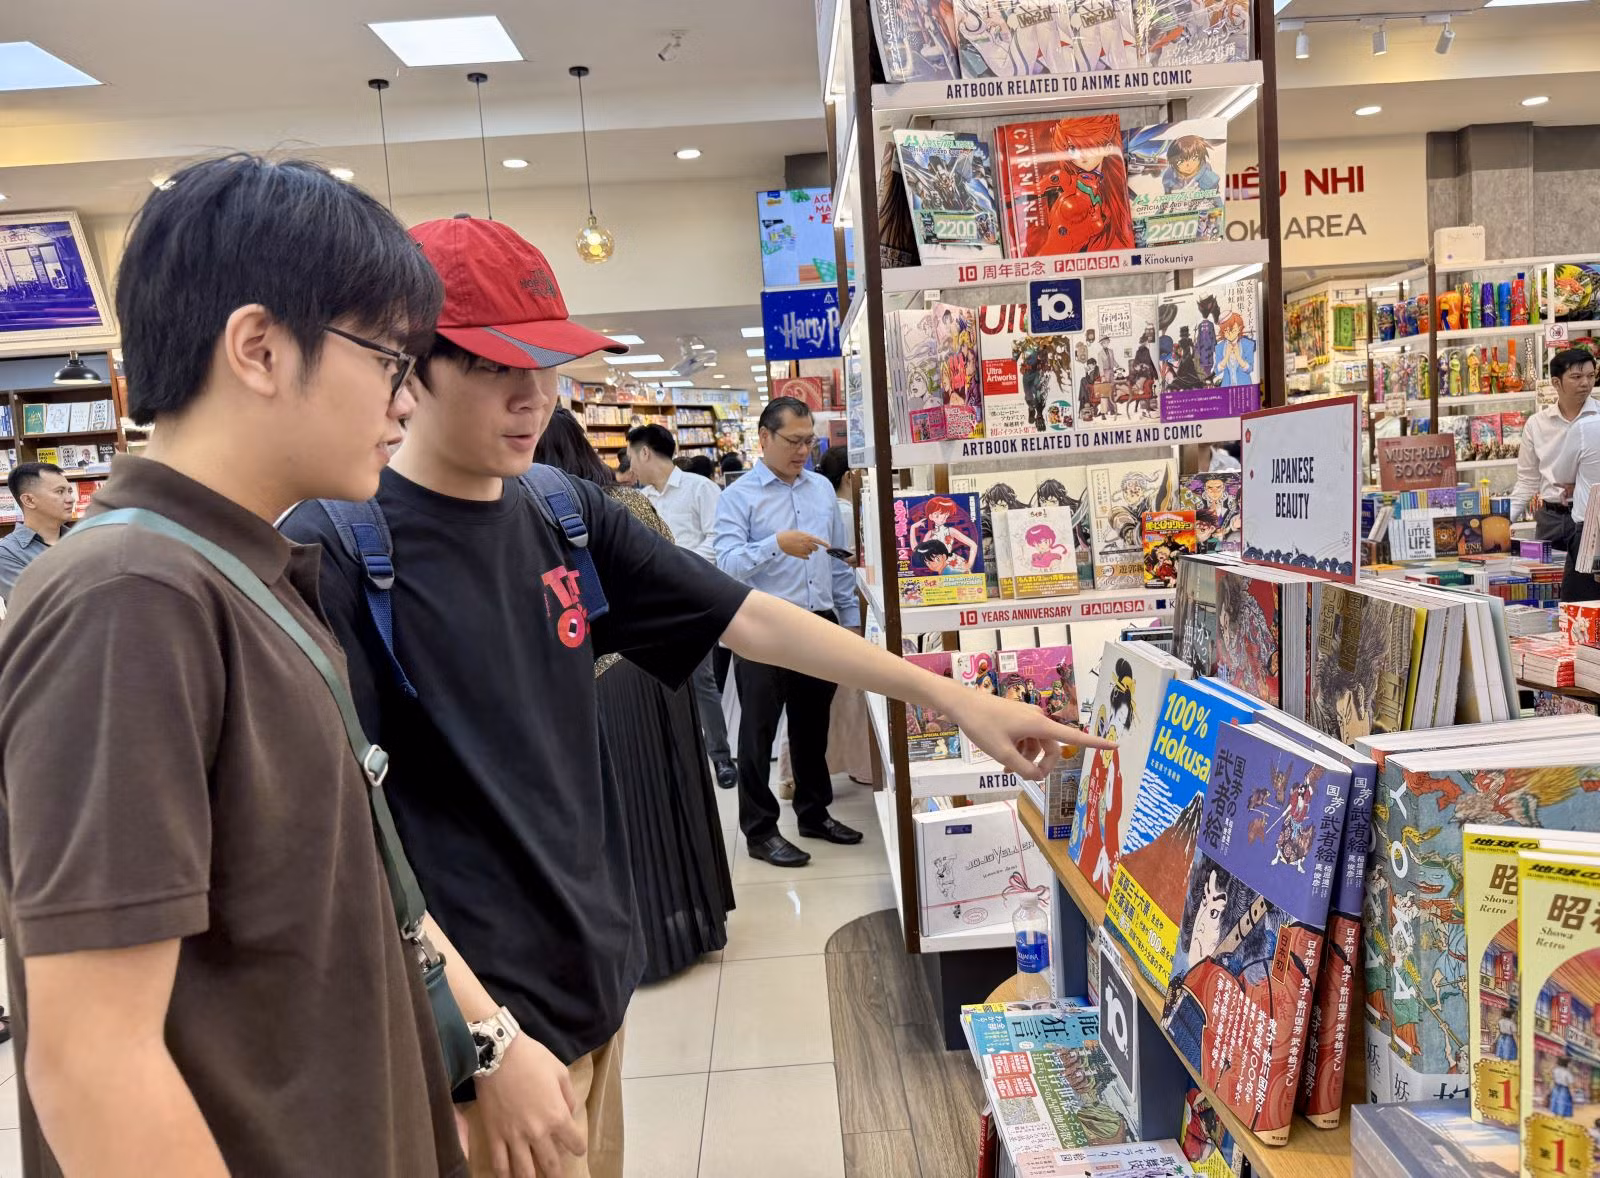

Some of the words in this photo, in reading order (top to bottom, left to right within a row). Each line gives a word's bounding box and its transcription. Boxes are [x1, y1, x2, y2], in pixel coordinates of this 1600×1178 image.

[947, 81, 1003, 99] ARTBOOK
[1008, 78, 1059, 95] RELATED
[1063, 77, 1077, 92] TO
[1082, 74, 1121, 91] ANIME
[1125, 72, 1149, 88] AND
[1153, 69, 1192, 86] COMIC
[1014, 129, 1039, 228] CARMINE
[1304, 165, 1364, 196] NHI
[936, 221, 976, 237] 2200
[1146, 220, 1198, 241] 2200
[1225, 219, 1261, 241] OK
[1283, 213, 1367, 240] AREA
[958, 266, 977, 283] 10
[983, 261, 1046, 279] 周年記念
[1055, 256, 1119, 272] FAHASA
[1144, 254, 1194, 265] Kinokuniya
[778, 311, 825, 350] Harry
[986, 367, 1002, 375] Ultra
[987, 374, 1017, 383] Artworks
[962, 437, 1018, 457] ARTBOOK
[1022, 433, 1070, 453] RELATED
[1074, 432, 1089, 448] TO
[1093, 429, 1132, 447] ANIME
[1136, 427, 1160, 444] AND
[1163, 424, 1203, 441] COMIC
[1385, 446, 1450, 463] MUST-READ
[1272, 457, 1314, 483] JAPANESE
[1395, 463, 1443, 479] BOOKS
[1276, 493, 1309, 519] BEAUTY
[1408, 528, 1430, 536] LITTLE
[1408, 537, 1431, 550] LIFE
[960, 610, 978, 626] 10
[981, 610, 1011, 622] YEARS
[1012, 605, 1073, 621] ANNIVERSARY
[1081, 600, 1144, 616] FAHASA
[1164, 692, 1211, 738] 100%
[1154, 726, 1211, 784] Hokusa
[979, 774, 1017, 789] ARTBO
[1227, 756, 1246, 817] 国芳の
[1203, 749, 1233, 849] 武者絵
[1314, 785, 1345, 863] 国芳の武者絵
[1346, 777, 1373, 854] 国芳の武者絵
[1471, 838, 1539, 849] 地球の
[1528, 863, 1600, 880] 地球の
[1480, 904, 1507, 914] Retro
[1483, 895, 1514, 905] Showa
[1536, 938, 1565, 950] Retro
[1540, 926, 1573, 940] Showa
[1275, 934, 1289, 973] 日本初
[1394, 1073, 1410, 1102] 妖
